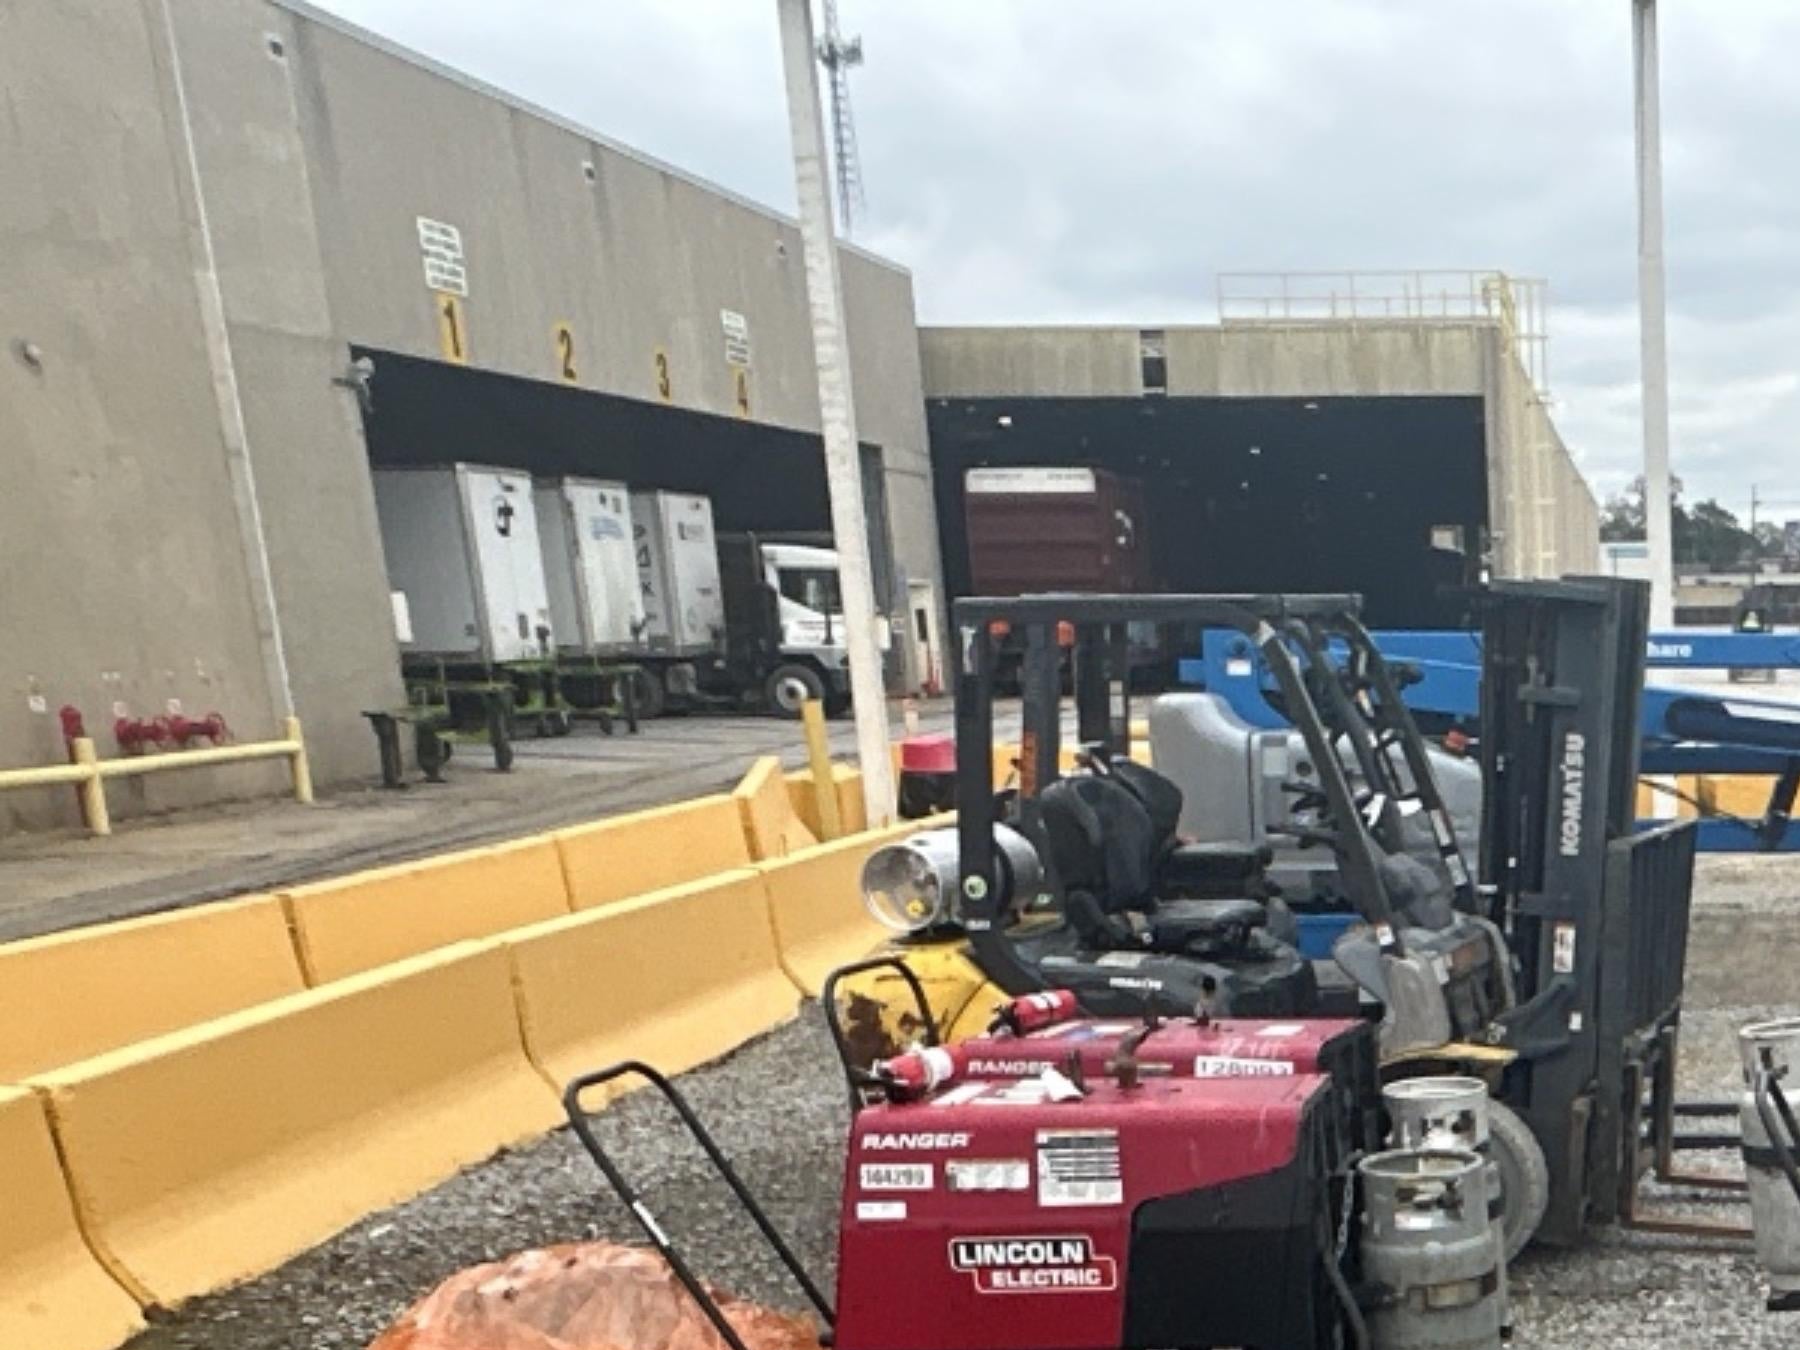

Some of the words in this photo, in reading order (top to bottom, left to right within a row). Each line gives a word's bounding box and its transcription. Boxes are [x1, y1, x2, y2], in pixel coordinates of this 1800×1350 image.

[443, 300, 461, 357] 1
[559, 329, 577, 380] 2
[656, 353, 670, 398] 3
[1560, 734, 1585, 856] KOMATSU
[860, 1133, 971, 1150] RANGER
[958, 1240, 1085, 1266] LINCOLN
[990, 1268, 1102, 1288] ELECTRIC
